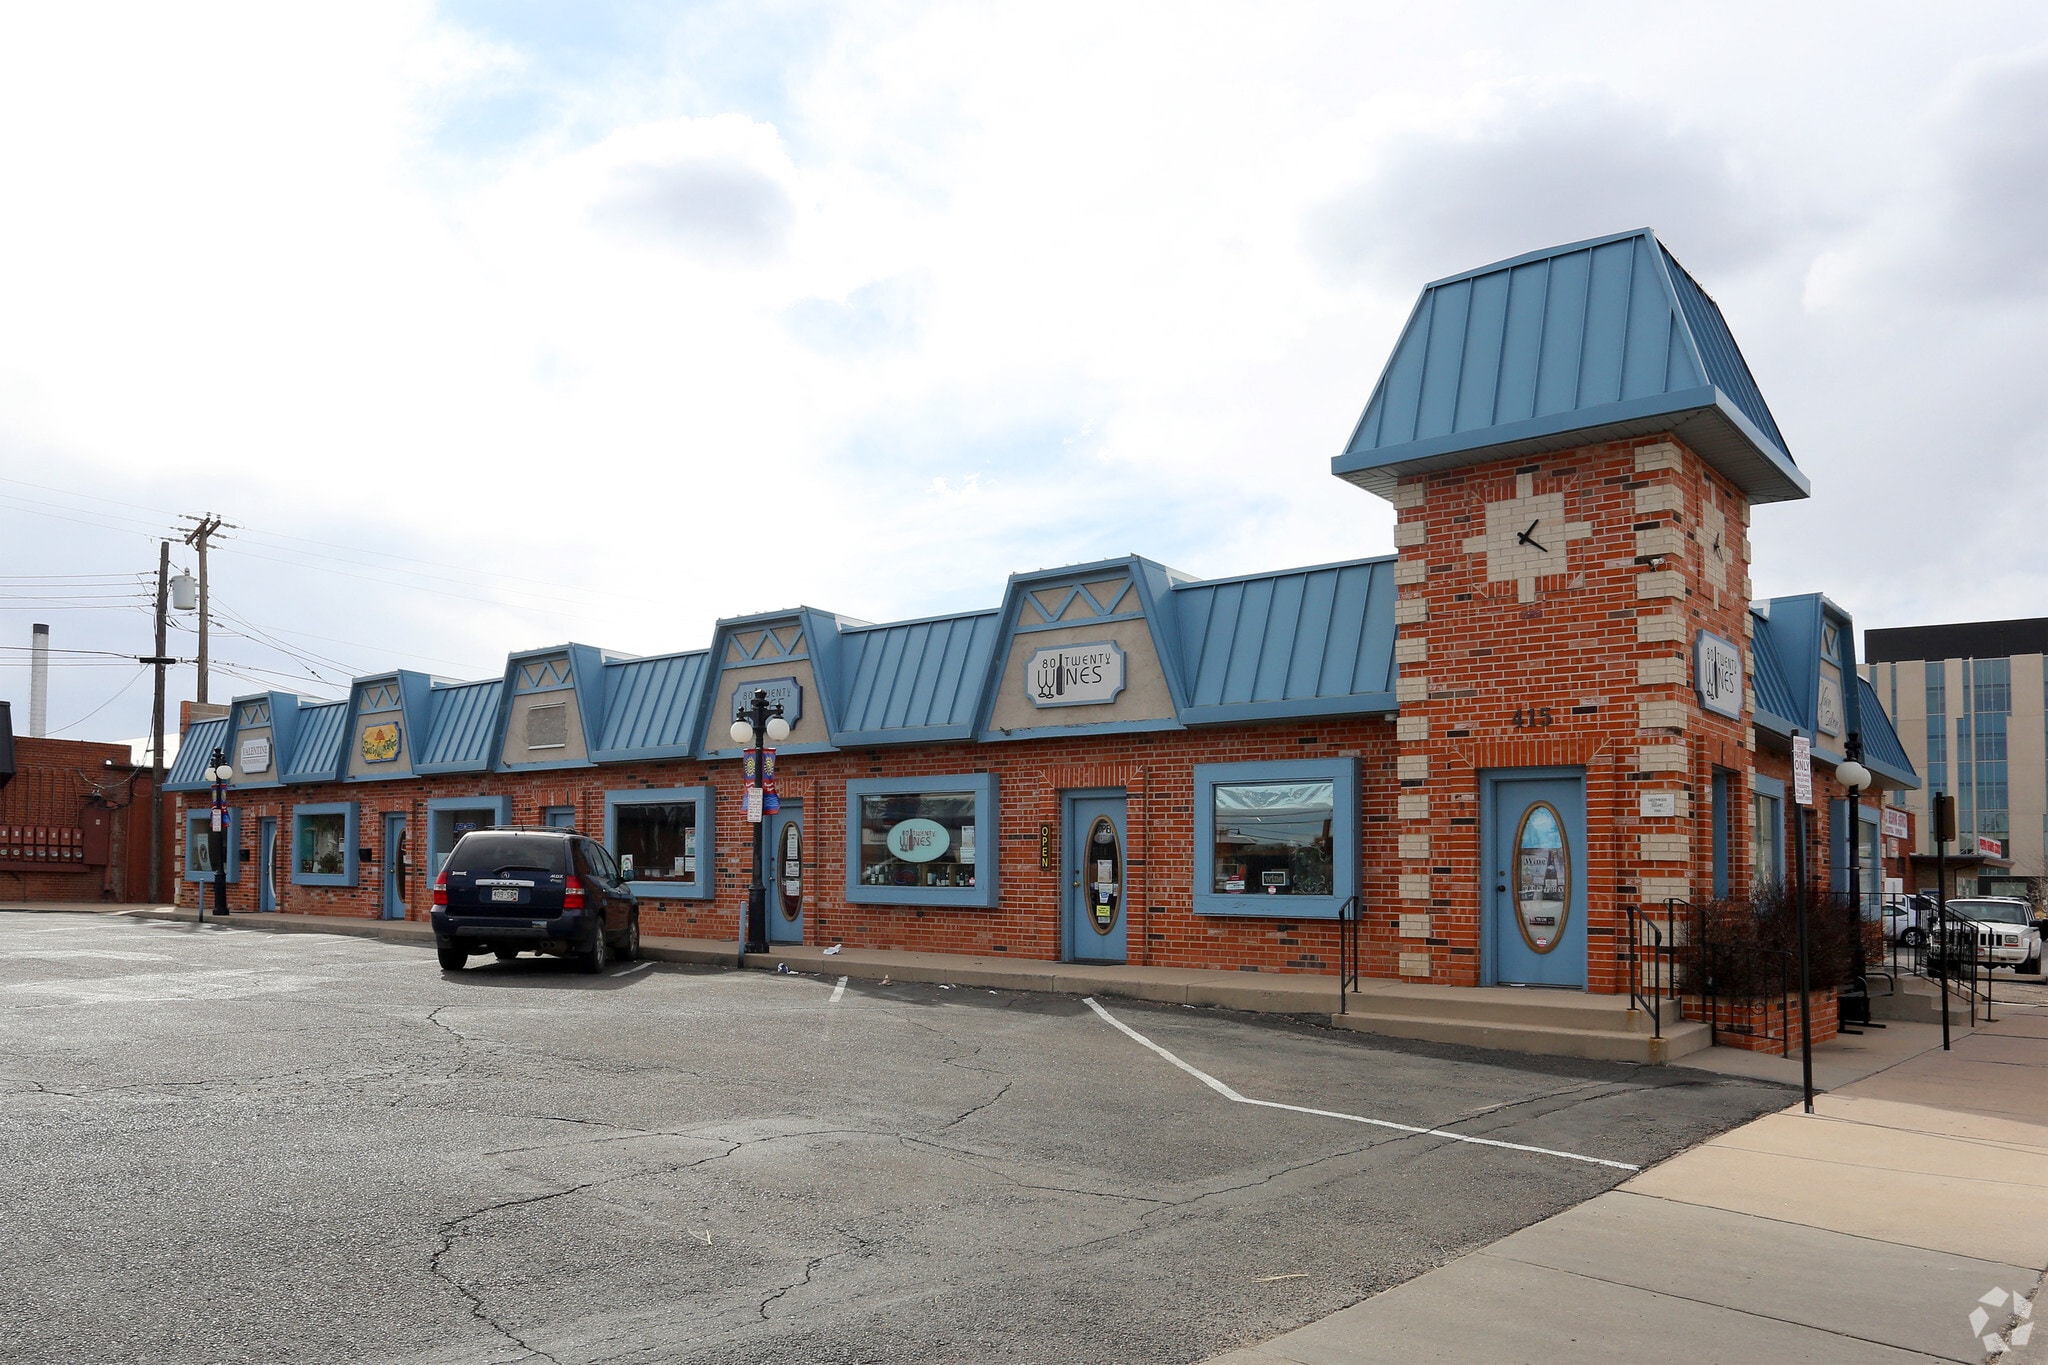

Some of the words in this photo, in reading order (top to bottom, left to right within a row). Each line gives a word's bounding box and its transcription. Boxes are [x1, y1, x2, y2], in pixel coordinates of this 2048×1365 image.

[1042, 658, 1056, 669] 80
[1064, 653, 1111, 667] TWENTY
[1717, 652, 1737, 675] TWENTY
[1037, 655, 1102, 699] WINES
[1705, 648, 1734, 700] WINES
[743, 691, 753, 700] 80
[1512, 707, 1552, 728] 415
[1794, 759, 1810, 771] ONLY
[899, 830, 931, 852] WINES
[1524, 857, 1547, 866] Wine
